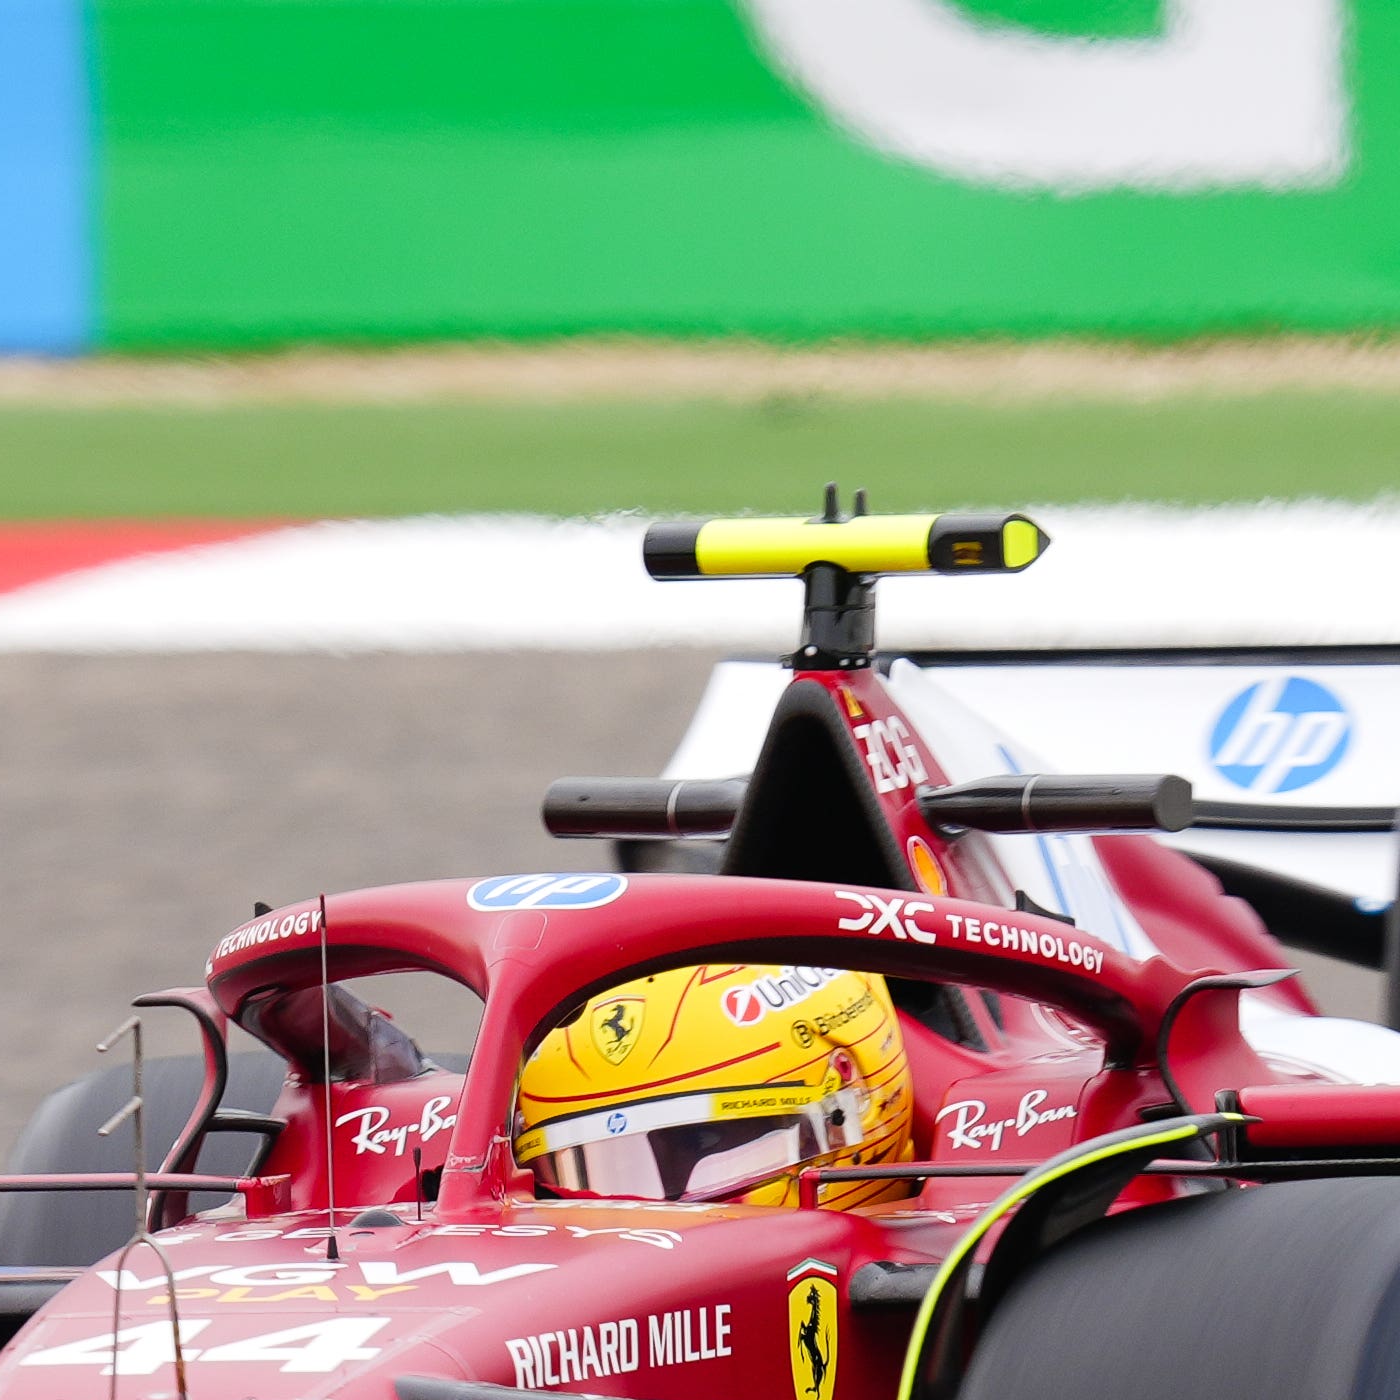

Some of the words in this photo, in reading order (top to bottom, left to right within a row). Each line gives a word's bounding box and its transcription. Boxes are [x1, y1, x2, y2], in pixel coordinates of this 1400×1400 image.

[1211, 677, 1352, 792] hp
[478, 873, 616, 909] hp
[215, 910, 323, 959] TECHNOLOGY
[834, 890, 936, 944] DXC
[946, 913, 1104, 975] TECHNOLOGY
[335, 1096, 458, 1156] Ray-Ba
[935, 1089, 1077, 1151] Ray-Ban
[96, 1262, 559, 1290] VGW
[147, 1285, 419, 1305] PLAY
[19, 1317, 392, 1376] 44
[505, 1318, 639, 1390] RICHARD
[648, 1304, 732, 1368] MILLE
